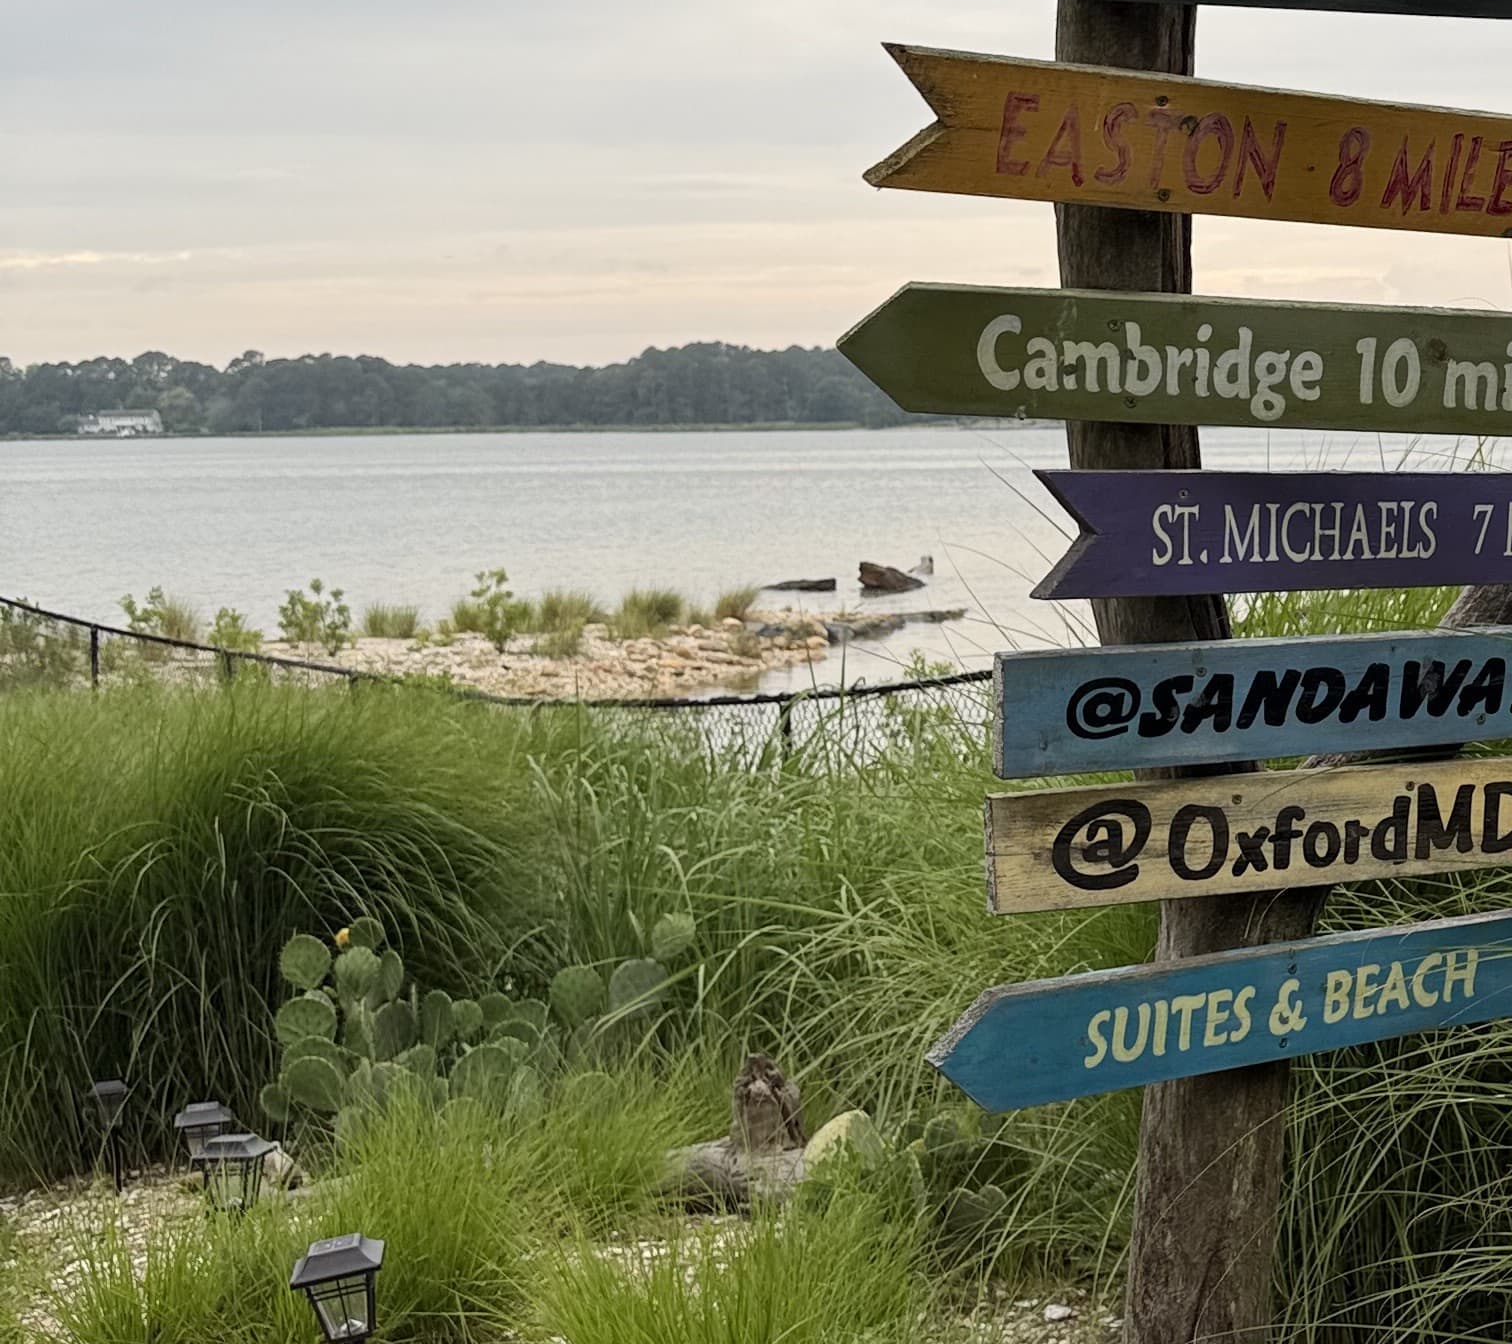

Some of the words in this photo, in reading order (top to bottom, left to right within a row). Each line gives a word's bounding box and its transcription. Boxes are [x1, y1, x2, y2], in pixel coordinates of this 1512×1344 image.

[995, 91, 1288, 202] EASTON
[1329, 126, 1371, 208] 8
[977, 314, 1323, 421] Cambridge
[1356, 336, 1422, 408] 10
[1151, 504, 1210, 566] ST.
[1222, 500, 1439, 563] MICHAELS
[1473, 504, 1494, 557] 7
[1083, 990, 1255, 1069] SUITES
[1269, 978, 1307, 1037] &
[1322, 948, 1480, 1026] BEACH
